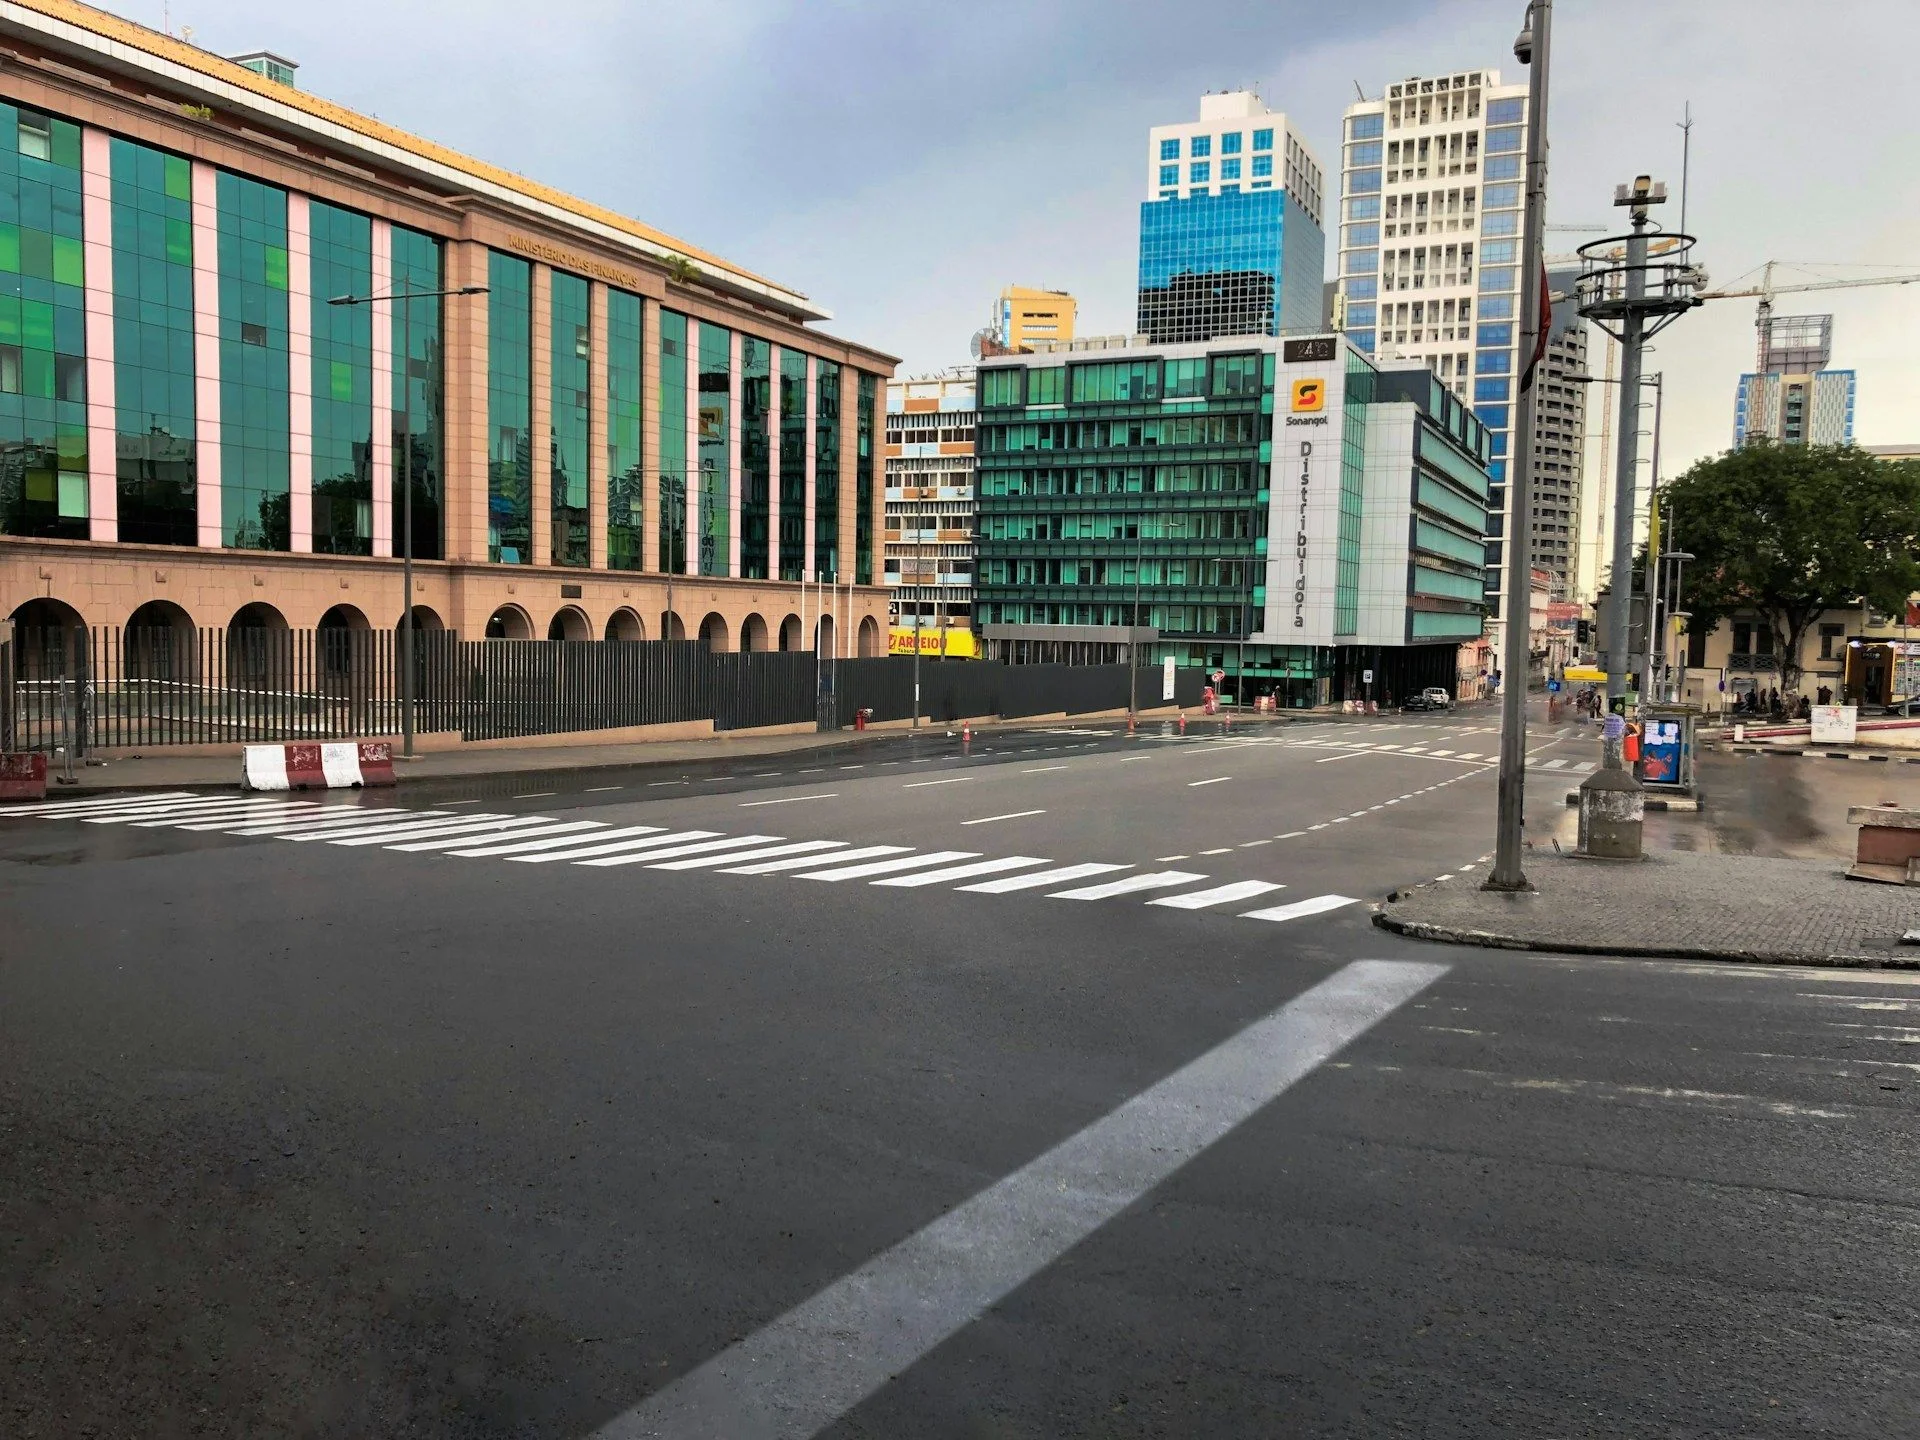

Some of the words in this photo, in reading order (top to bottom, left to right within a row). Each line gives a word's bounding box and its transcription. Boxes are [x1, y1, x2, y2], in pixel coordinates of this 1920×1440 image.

[568, 256, 591, 272] DAS
[590, 264, 638, 287] FINANÇAS
[1285, 416, 1328, 427] Sonangol
[1294, 441, 1312, 628] Distribuidora
